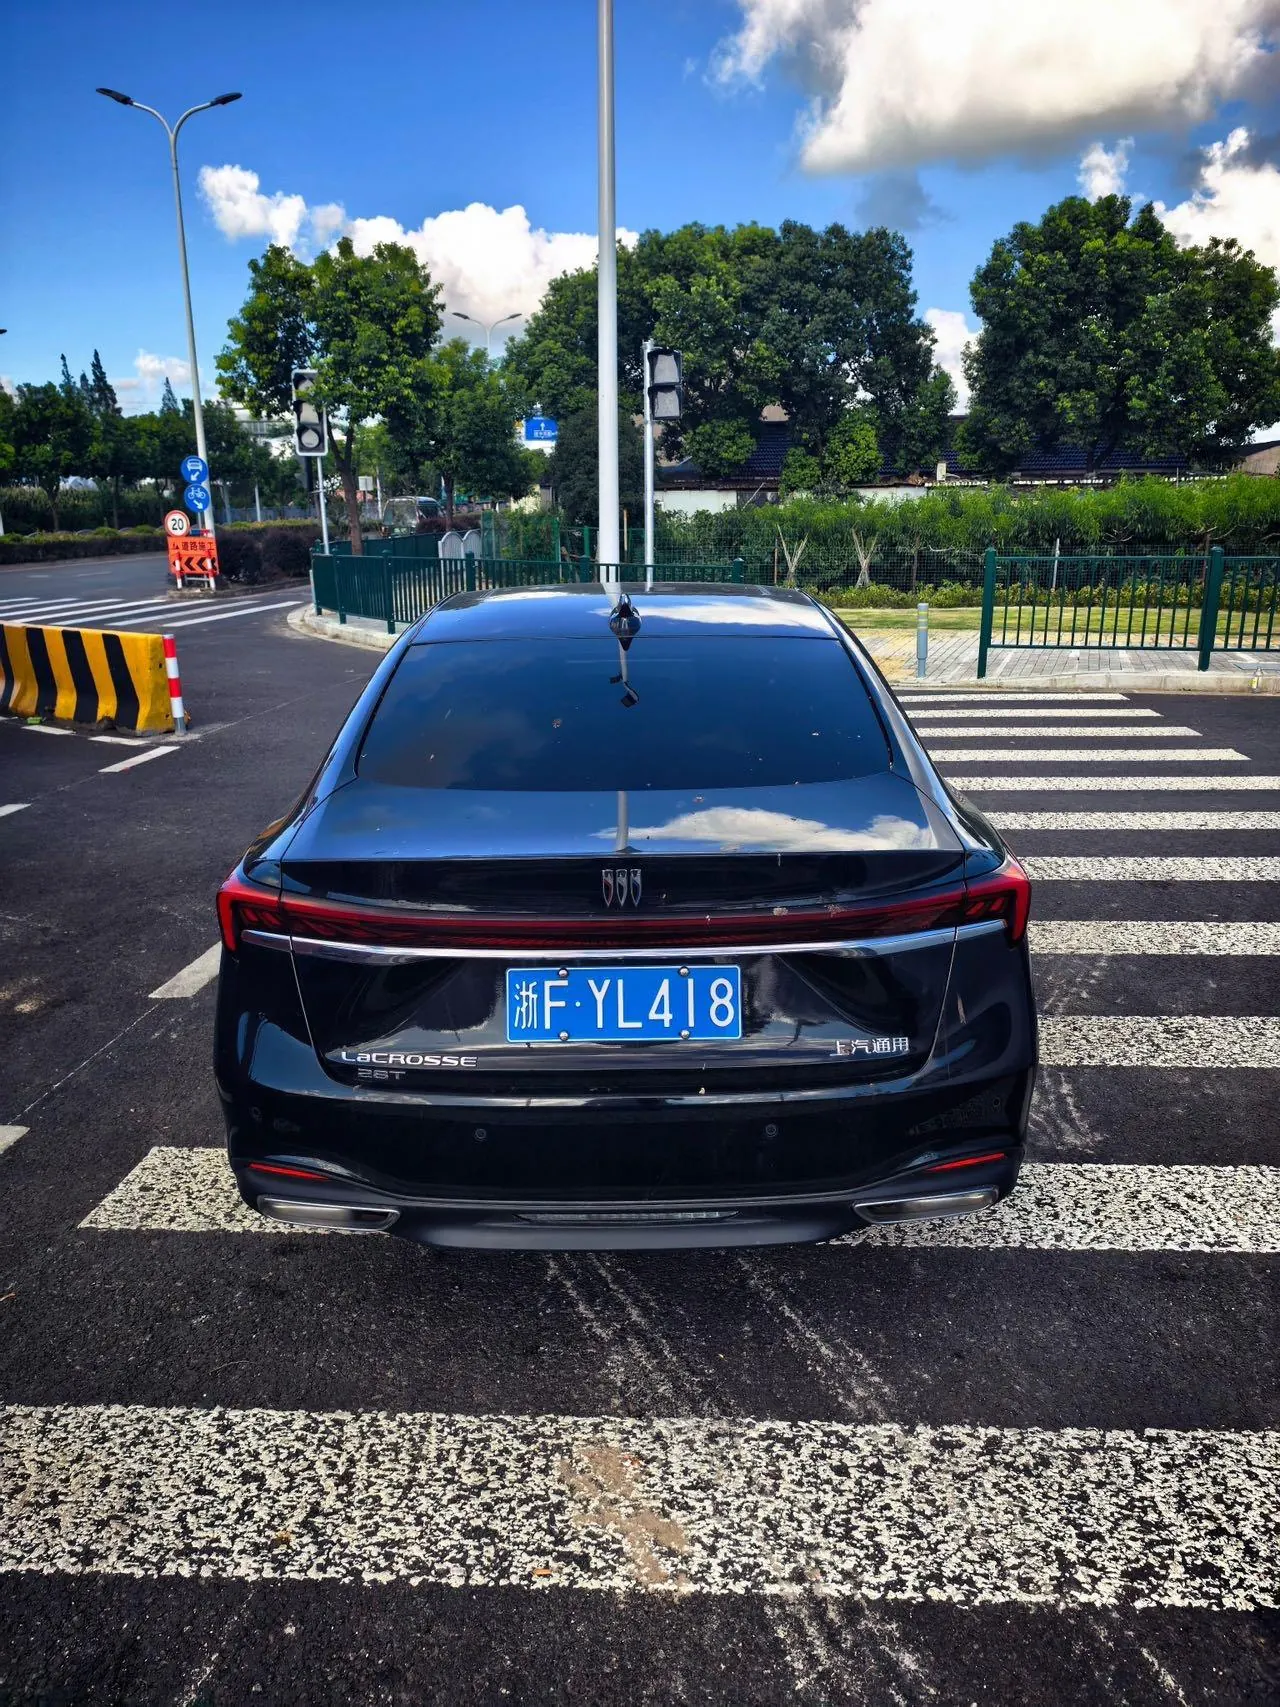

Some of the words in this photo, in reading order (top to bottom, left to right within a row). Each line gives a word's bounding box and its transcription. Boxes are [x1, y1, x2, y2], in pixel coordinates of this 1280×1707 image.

[171, 518, 184, 531] 20
[181, 541, 214, 551] 道路施工
[829, 1036, 909, 1057] 上汽通用
[358, 1068, 406, 1080] 28T
